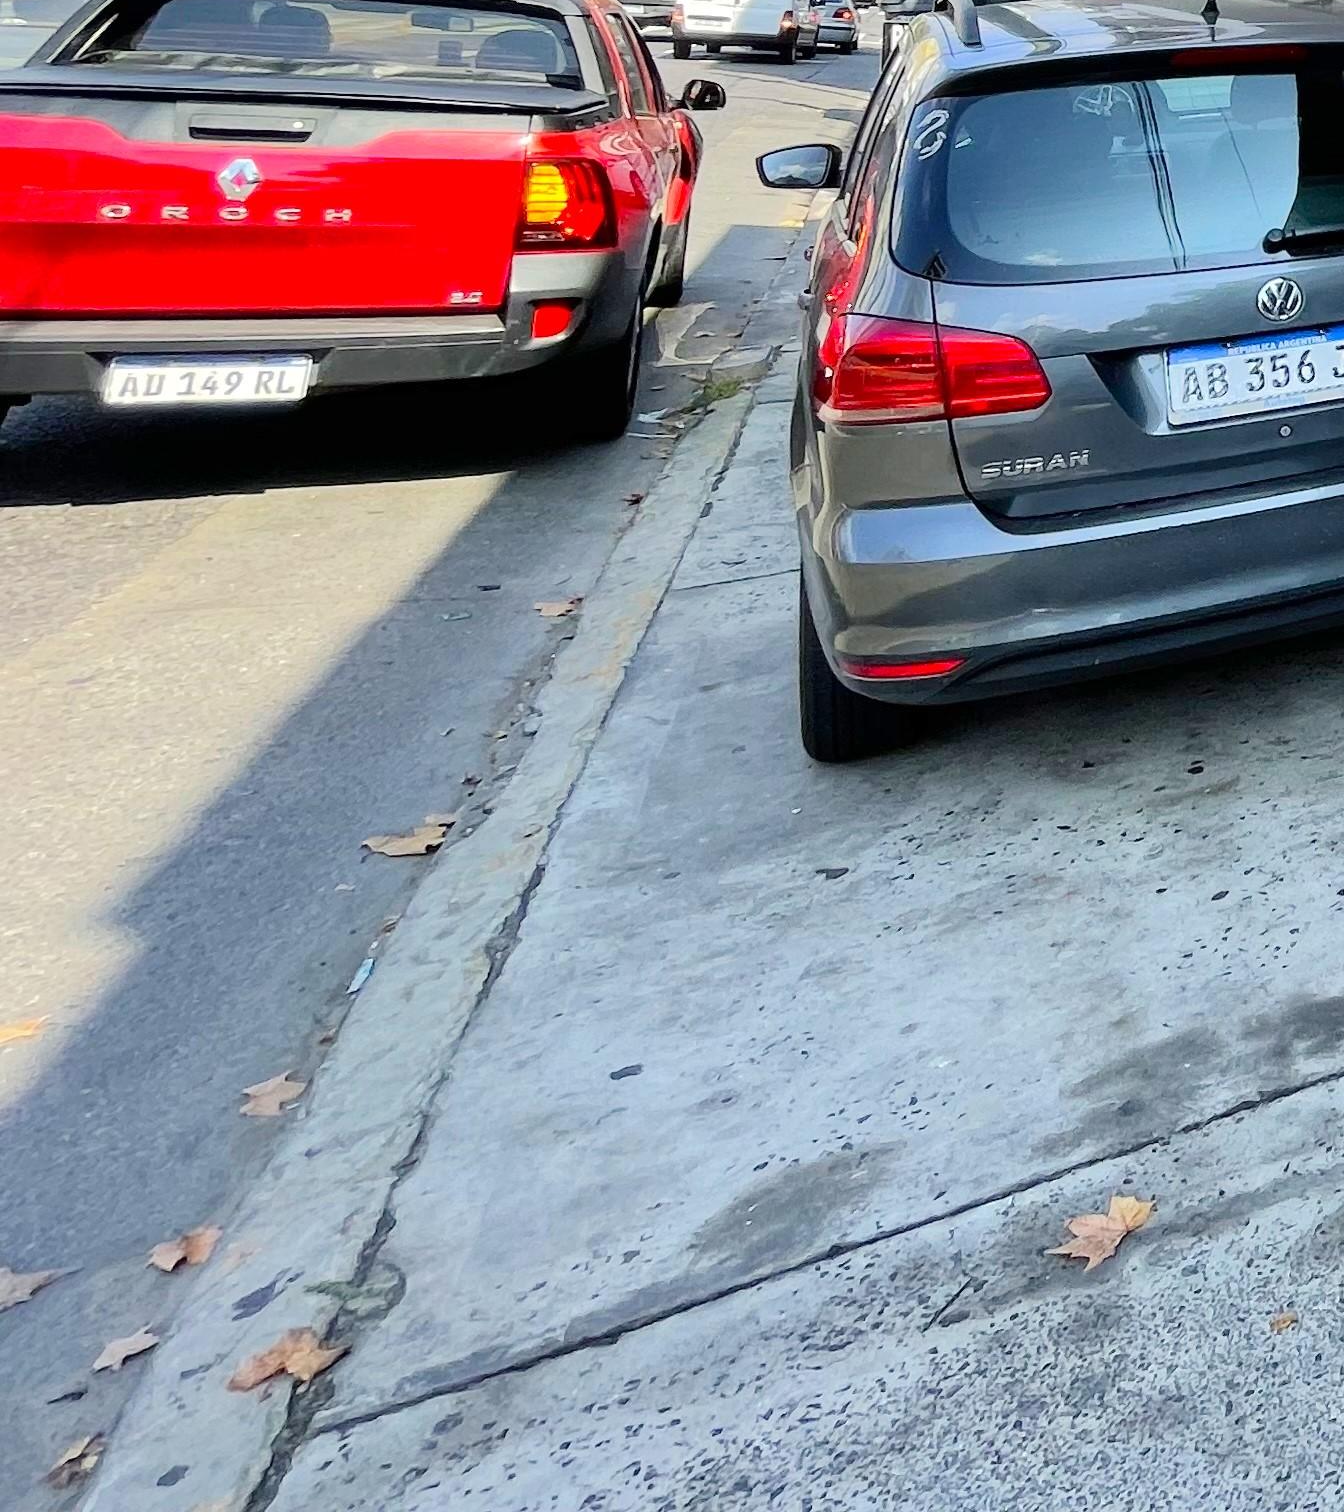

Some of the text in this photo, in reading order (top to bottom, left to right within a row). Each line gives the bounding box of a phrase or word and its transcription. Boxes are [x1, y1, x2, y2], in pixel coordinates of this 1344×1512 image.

[100, 204, 352, 224] OROCH
[1278, 335, 1328, 348] ARGENTINA
[117, 371, 296, 398] AD 149 RL
[1182, 363, 1230, 403] AB
[1245, 349, 1317, 392] 356
[981, 449, 1090, 479] SURAN
